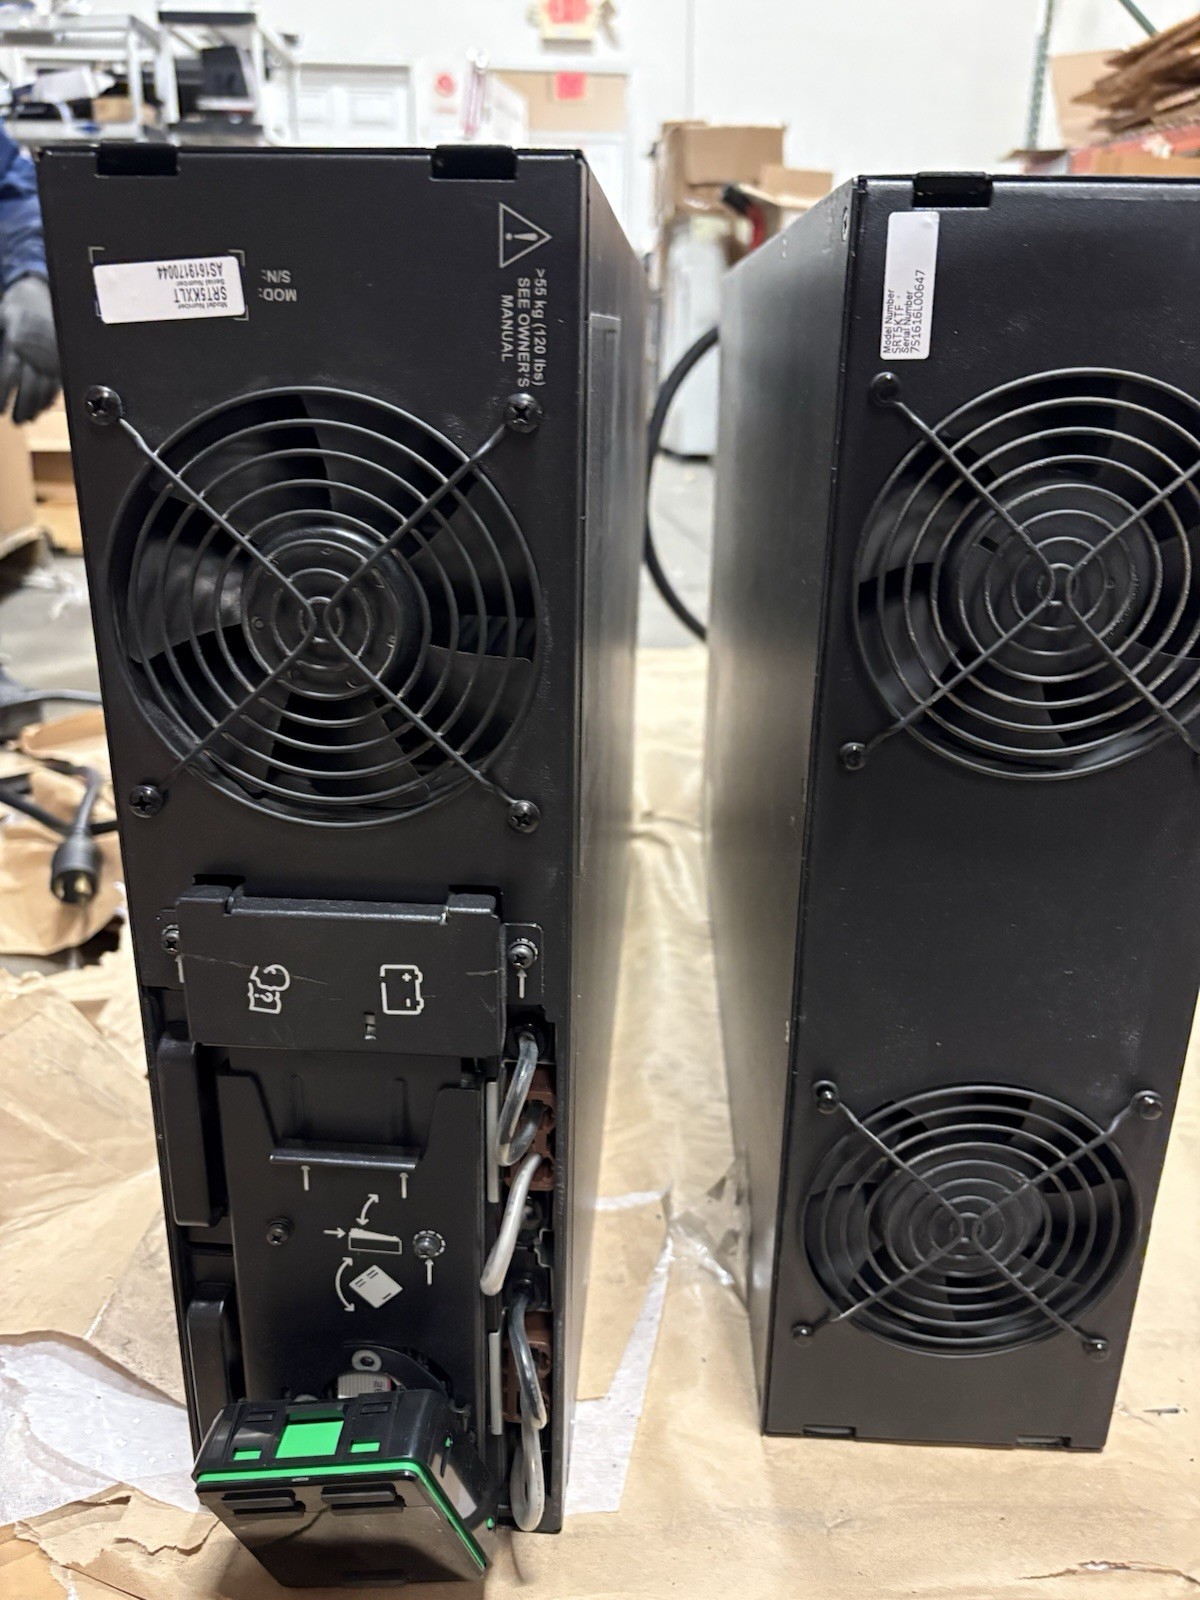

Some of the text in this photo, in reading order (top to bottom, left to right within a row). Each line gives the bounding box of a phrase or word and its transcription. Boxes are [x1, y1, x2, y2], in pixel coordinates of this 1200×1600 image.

[157, 262, 223, 280] AS1619170044
[174, 286, 228, 303] SRT5KXLT
[258, 287, 297, 302] MOD:
[260, 269, 291, 284] S/N:
[178, 302, 205, 310] Number
[501, 294, 514, 362] MANUAL
[517, 277, 531, 388] SEE OWNER'S
[531, 268, 548, 386] >55 kg (120 lbs)
[883, 289, 895, 354] Model Number
[892, 305, 904, 354] SRT5KTF
[901, 291, 913, 354] Serial Number
[910, 269, 926, 354] 7S1616L00647
